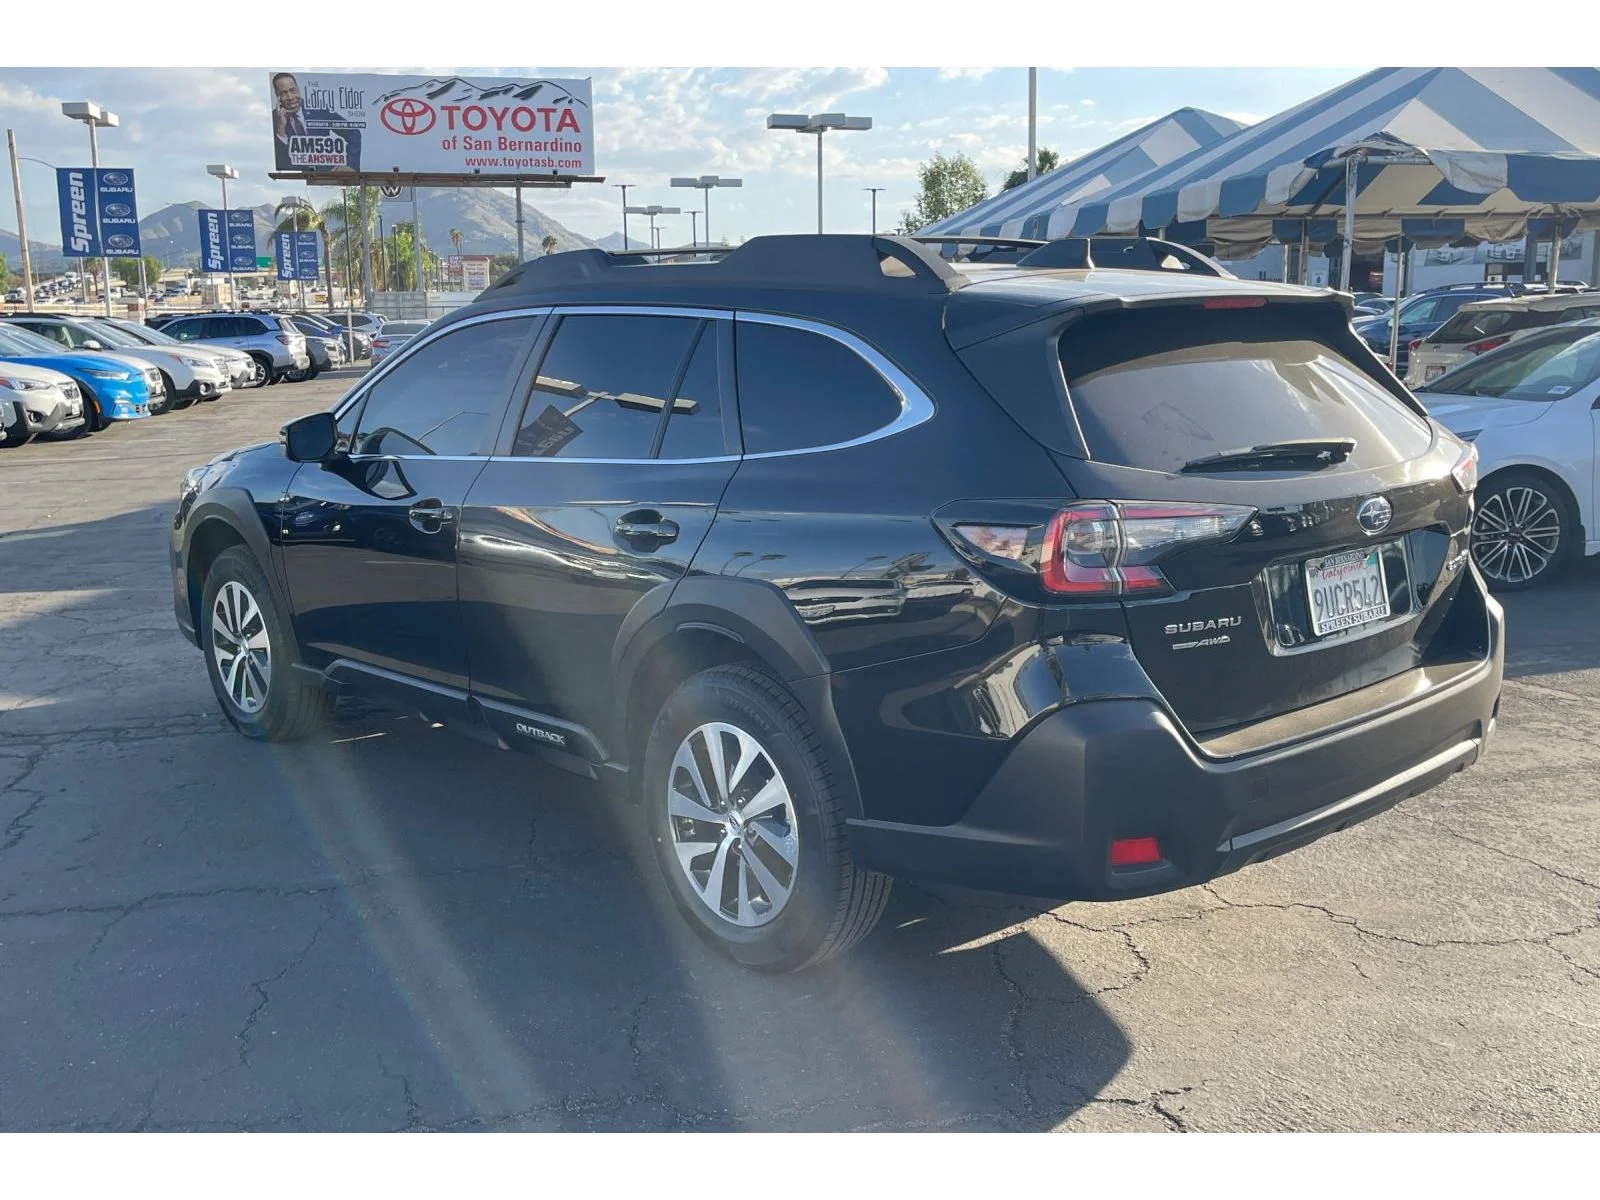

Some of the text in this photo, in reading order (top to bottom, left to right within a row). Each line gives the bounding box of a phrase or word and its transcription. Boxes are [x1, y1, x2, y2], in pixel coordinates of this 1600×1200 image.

[304, 86, 365, 112] Larry Elder
[441, 105, 581, 133] TOYOTA
[290, 137, 344, 154] AM590
[442, 136, 582, 153] of San Bernardino
[291, 154, 345, 164] THE ANSWER
[465, 156, 582, 170] www.toyotasb.com
[69, 172, 93, 252] Spreen
[207, 212, 224, 270] Spreen
[281, 234, 294, 278] Spreen
[1322, 561, 1368, 580] California
[1313, 575, 1383, 622] 9UCR542
[1164, 616, 1242, 634] SUBARU
[1321, 606, 1385, 631] SPREEN SUBARU
[1195, 635, 1231, 648] AWD
[516, 723, 565, 745] OUTBACK
